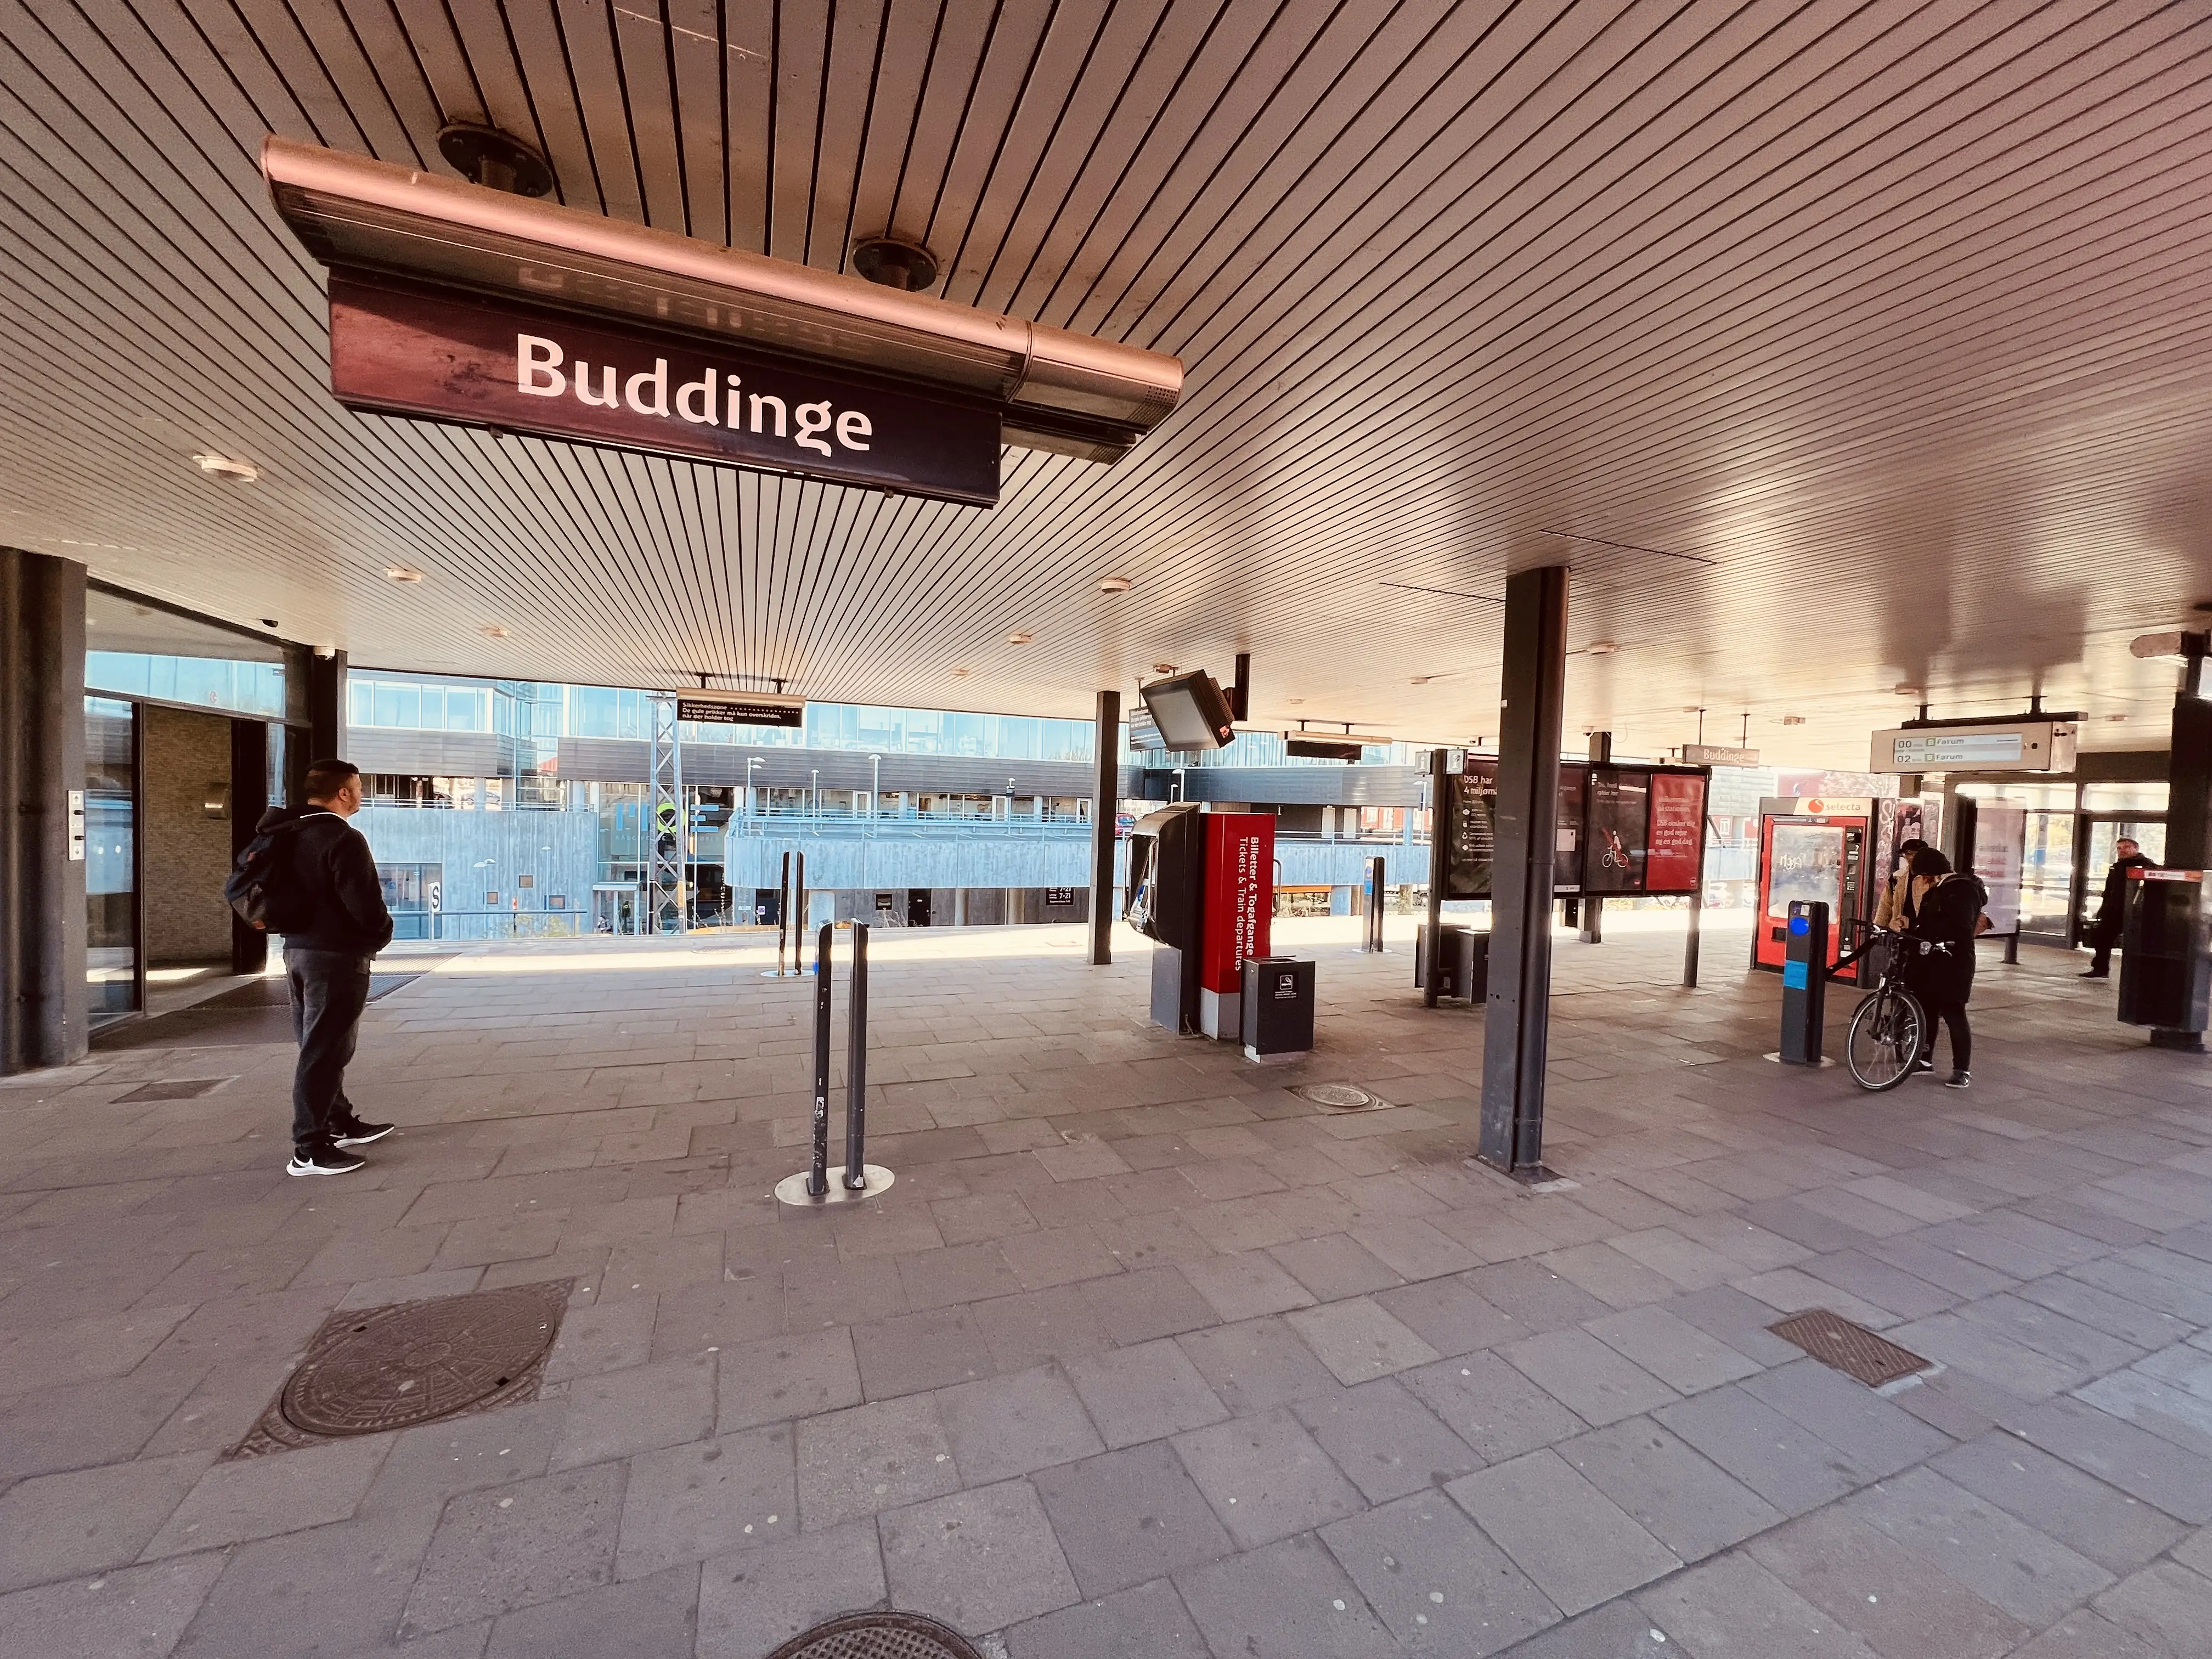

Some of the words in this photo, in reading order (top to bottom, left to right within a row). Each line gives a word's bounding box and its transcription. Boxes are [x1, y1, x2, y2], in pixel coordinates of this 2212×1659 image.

[516, 332, 873, 458] Buddinge
[1703, 748, 1745, 764] Buddinge
[1464, 775, 1479, 784] DSB
[1480, 775, 1493, 784] har
[1826, 803, 1861, 811] selecta
[1238, 837, 1248, 873] Tickets
[1249, 837, 1259, 881] Billetter
[1237, 887, 1246, 912] Train
[1249, 883, 1257, 891] &
[1245, 893, 1257, 956] Togafgange
[1235, 916, 1245, 971] departures
